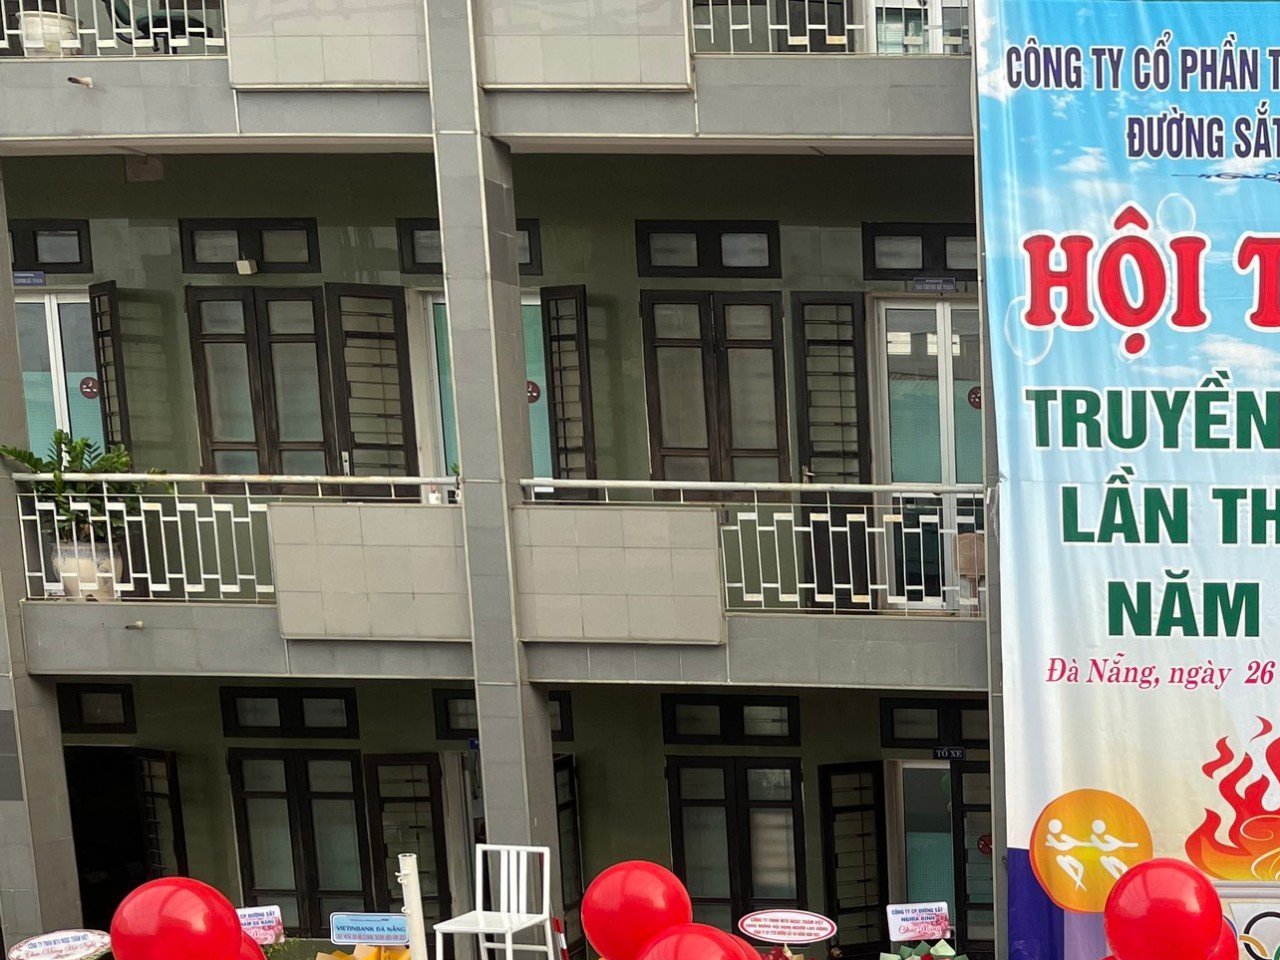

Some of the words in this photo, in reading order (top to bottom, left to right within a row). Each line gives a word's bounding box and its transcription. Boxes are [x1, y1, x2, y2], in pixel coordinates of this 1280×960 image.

[1007, 38, 1082, 89] CÔNG
[1092, 47, 1125, 90] TY
[1133, 31, 1171, 91] CỔ
[1181, 34, 1260, 90] PHẦN
[1126, 107, 1224, 158] ĐƯỜNG
[1023, 205, 1208, 354] HỘI
[1026, 370, 1280, 449] TRUYỀN
[1062, 466, 1189, 544] LẦN
[1108, 569, 1260, 637] NĂM
[1046, 657, 1080, 682] Đà
[1086, 653, 1160, 686] Nẵng,
[1168, 661, 1231, 690] ngày
[1245, 662, 1276, 685] 26
[950, 750, 962, 758] XE
